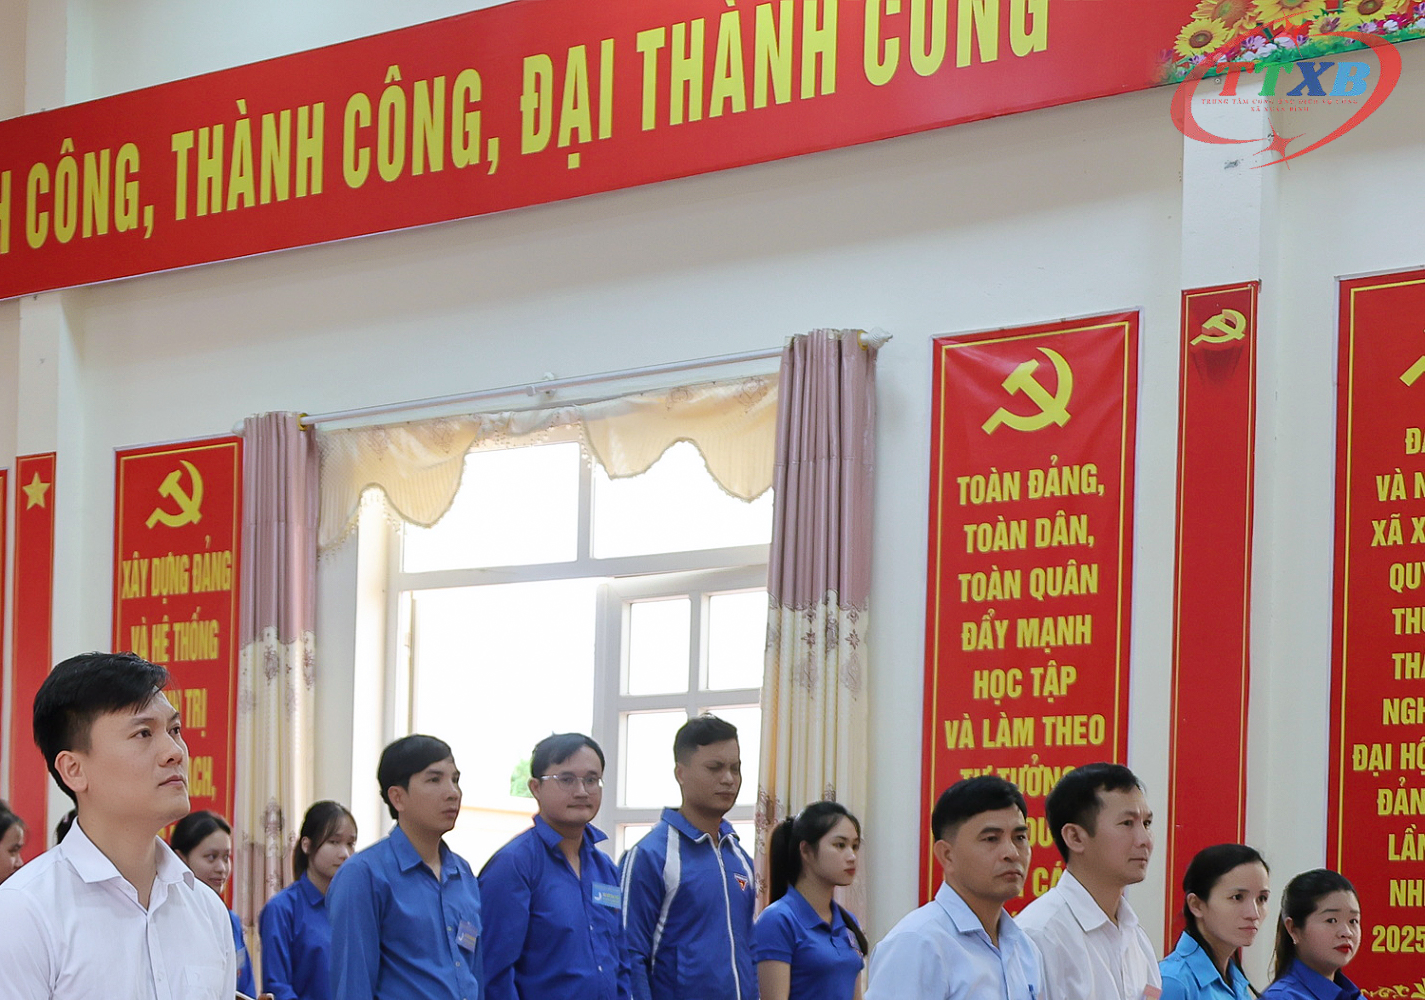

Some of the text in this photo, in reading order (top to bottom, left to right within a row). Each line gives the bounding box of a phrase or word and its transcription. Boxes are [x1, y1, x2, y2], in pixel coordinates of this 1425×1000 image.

[26, 137, 154, 239] CÔNG,
[172, 99, 324, 220] THÀNH
[343, 67, 500, 188] CÔNG,
[520, 38, 615, 169] ĐẠI
[636, 0, 837, 131] THÀNH
[957, 454, 1105, 505] TOÀN ĐẢNG,
[1376, 468, 1406, 501] VÀ
[964, 510, 1094, 553] TOÀN DÂN,
[1371, 513, 1403, 547] XÃ
[122, 535, 232, 604] XÂY DỰNG ĐẢNG
[958, 559, 1098, 602] TOÀN QUÂN
[173, 606, 219, 661] THỐNG
[961, 608, 1092, 654] ĐẨY MẠNH
[974, 660, 1077, 705] HỌC TẬP
[185, 688, 207, 737] TRỊ
[944, 712, 1106, 749] VÀ LÀM THEO
[1352, 743, 1391, 776] ĐẠI
[1372, 925, 1425, 953] 2025
